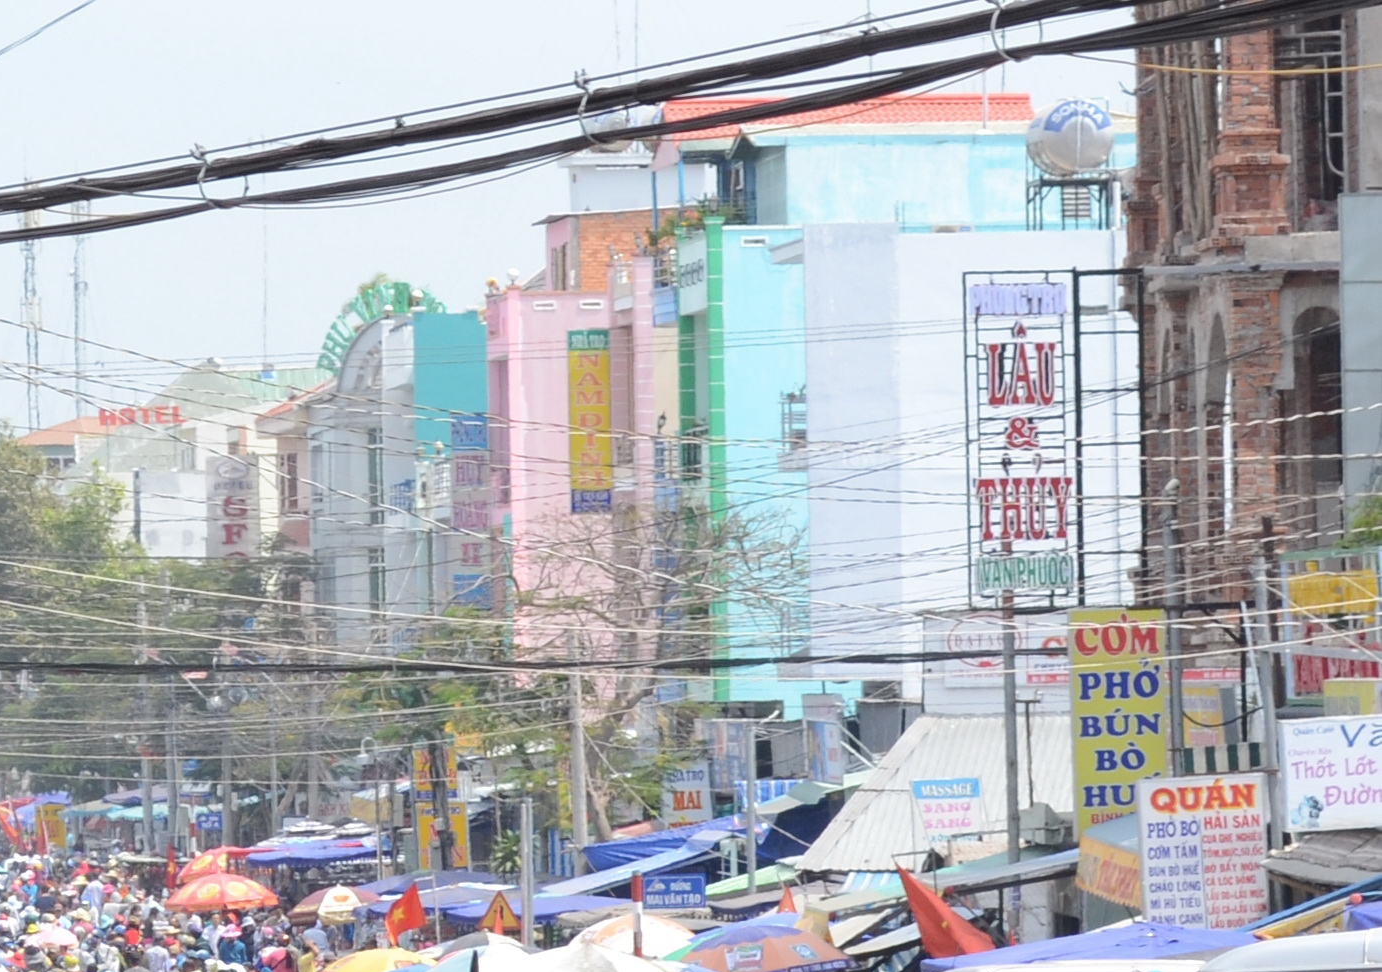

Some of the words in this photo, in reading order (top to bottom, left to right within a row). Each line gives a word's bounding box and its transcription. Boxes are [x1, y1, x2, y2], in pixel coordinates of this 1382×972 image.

[99, 405, 187, 426] HOTEL
[1005, 416, 1040, 450] &
[1074, 613, 1160, 657] CƠM
[1078, 656, 1160, 701] PHỞ
[1079, 708, 1162, 738] BÚN
[1095, 742, 1146, 772] BÒ
[673, 790, 703, 812] MAI
[1149, 778, 1257, 814] QUÁN
